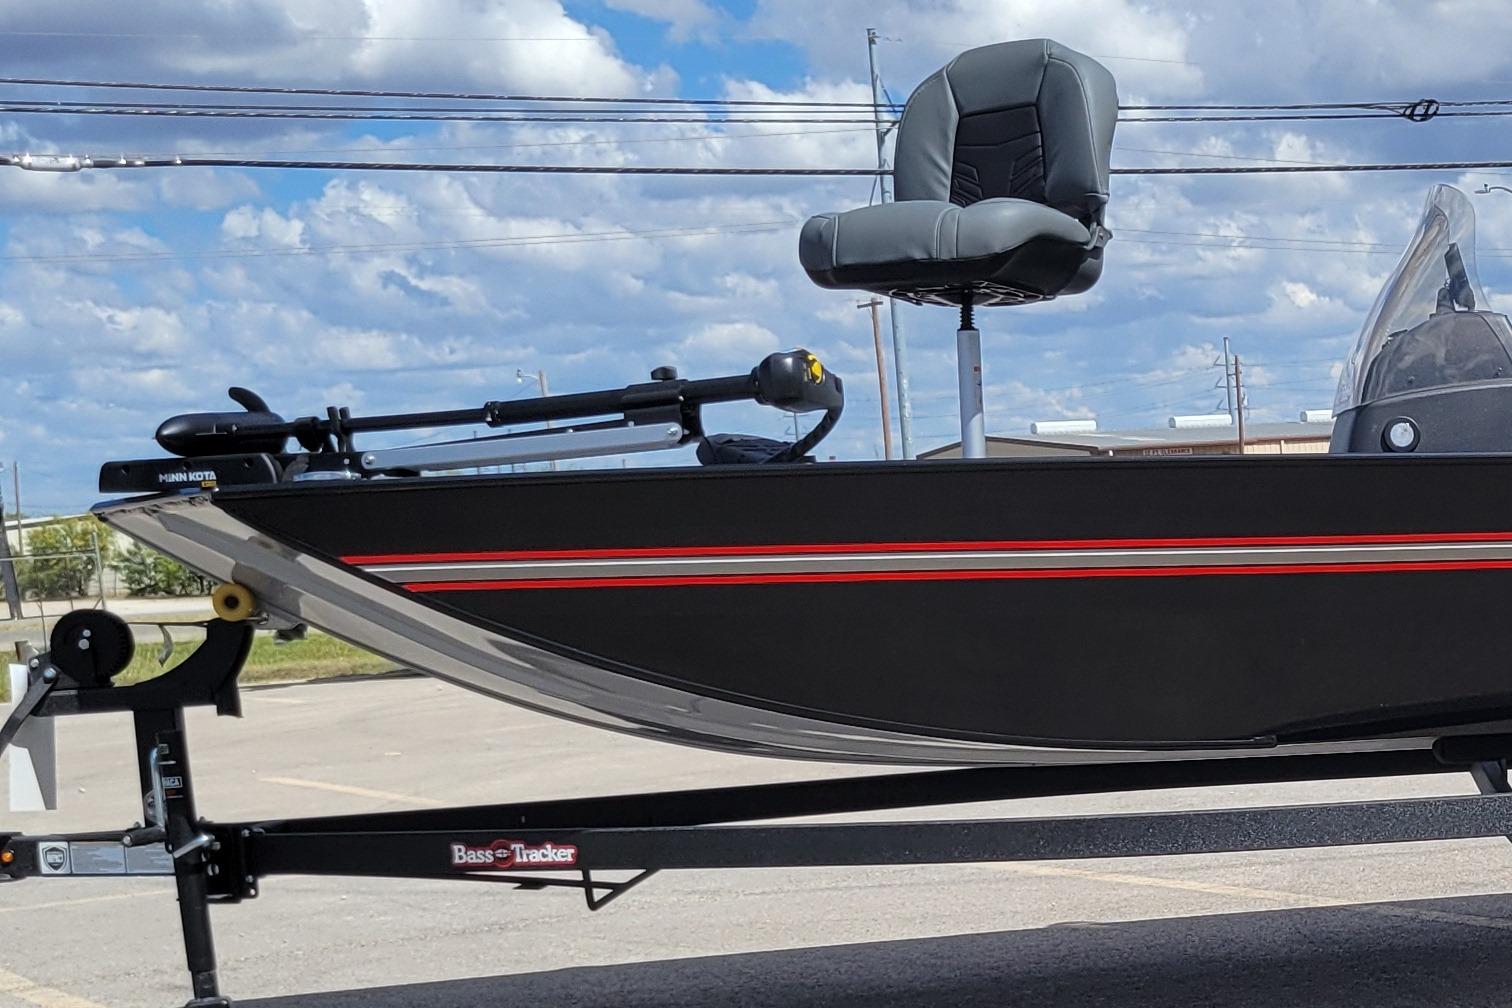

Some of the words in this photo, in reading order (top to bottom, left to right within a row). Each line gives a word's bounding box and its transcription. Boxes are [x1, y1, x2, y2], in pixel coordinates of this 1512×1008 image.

[158, 472, 188, 482] MINN
[188, 470, 217, 481] KOTA
[452, 845, 494, 864] Bass
[511, 843, 575, 863] Tracker
